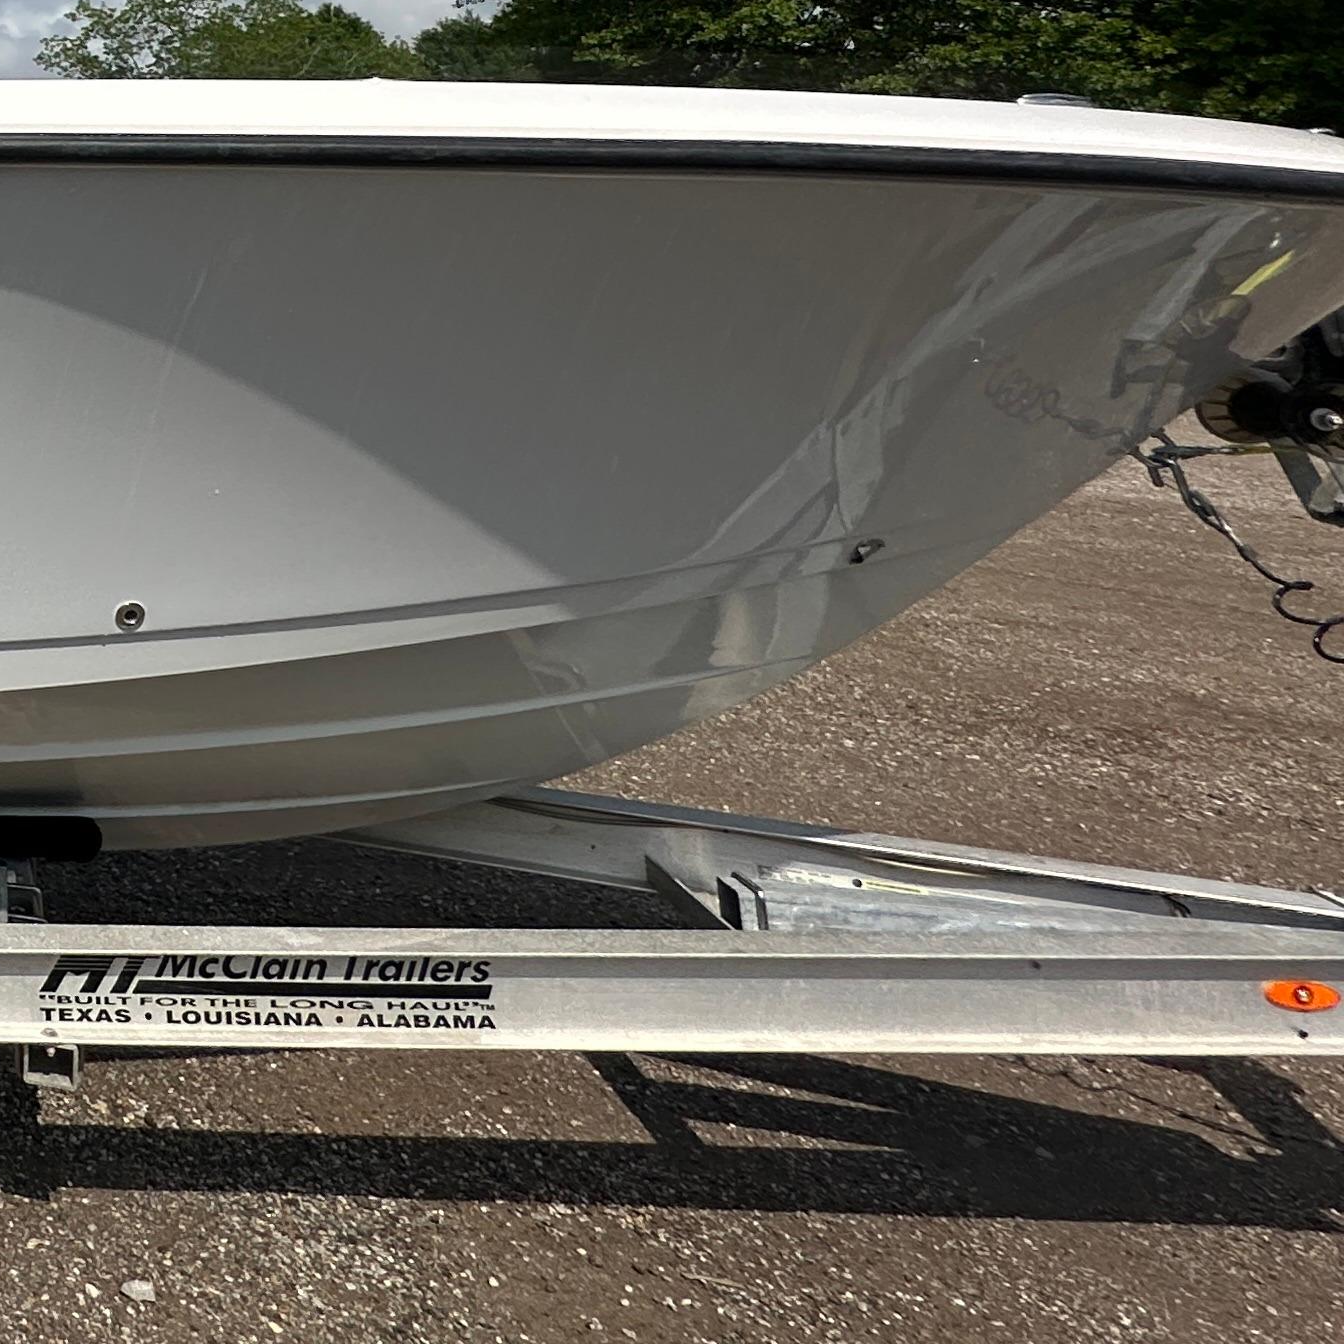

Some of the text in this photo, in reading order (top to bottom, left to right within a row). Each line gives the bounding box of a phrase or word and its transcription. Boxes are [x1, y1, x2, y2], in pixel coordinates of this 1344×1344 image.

[155, 956, 491, 983] McClain Trailers
[140, 996, 197, 1007] FOR
[205, 998, 258, 1008] THE
[270, 999, 375, 1010] LONG
[40, 1008, 497, 1030] TEXAS LOUISIANA ALABAMA
